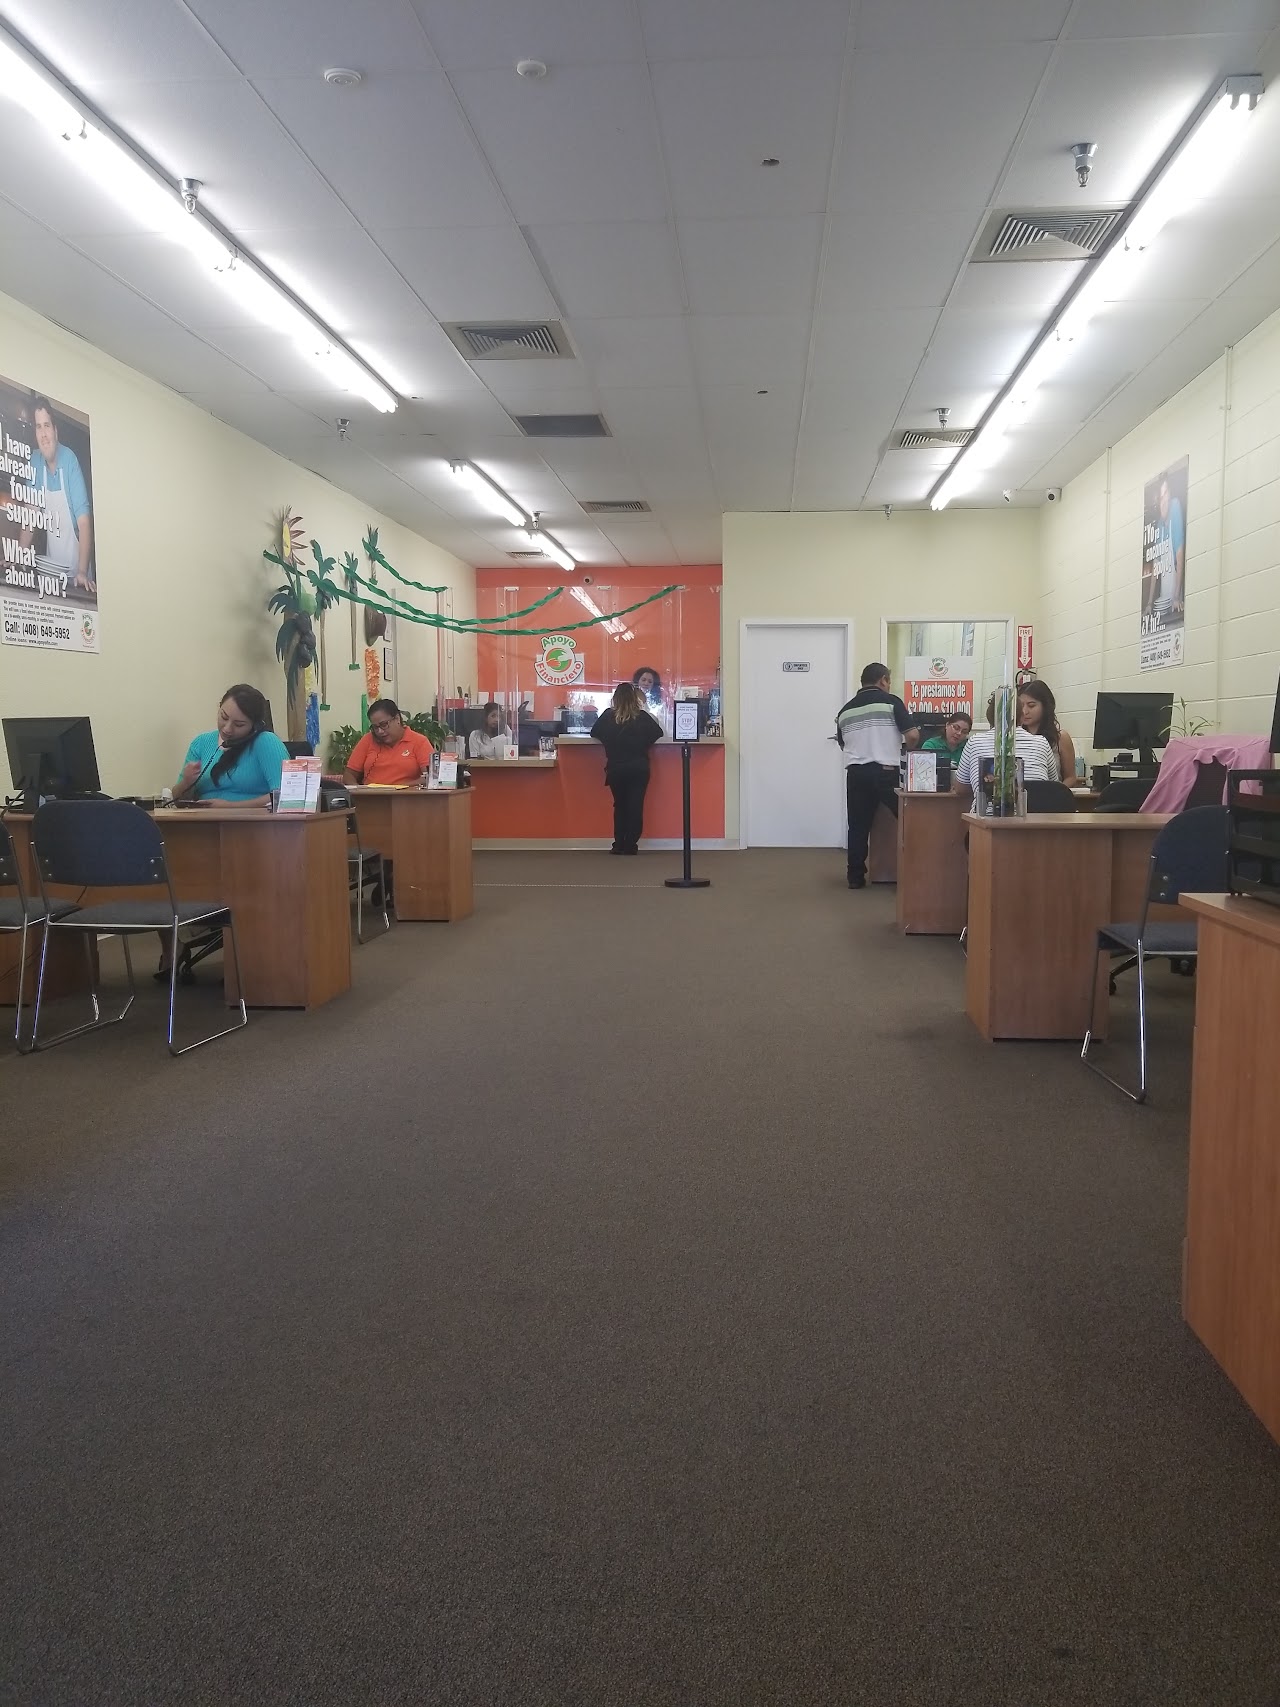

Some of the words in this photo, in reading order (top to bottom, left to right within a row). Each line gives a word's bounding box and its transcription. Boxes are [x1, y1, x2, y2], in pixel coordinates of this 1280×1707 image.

[6, 432, 32, 461] have
[0, 452, 37, 486] already
[10, 475, 46, 509] found
[1, 536, 37, 568] What
[5, 565, 36, 589] about
[37, 573, 68, 600] you?
[5, 620, 20, 634] Call:
[22, 622, 39, 639] (408)
[41, 625, 70, 640] 649-5952
[542, 636, 575, 648] Apoyo
[536, 662, 582, 684] Financiero
[910, 681, 919, 698] Te
[920, 681, 956, 701] prestamos
[957, 680, 966, 698] de
